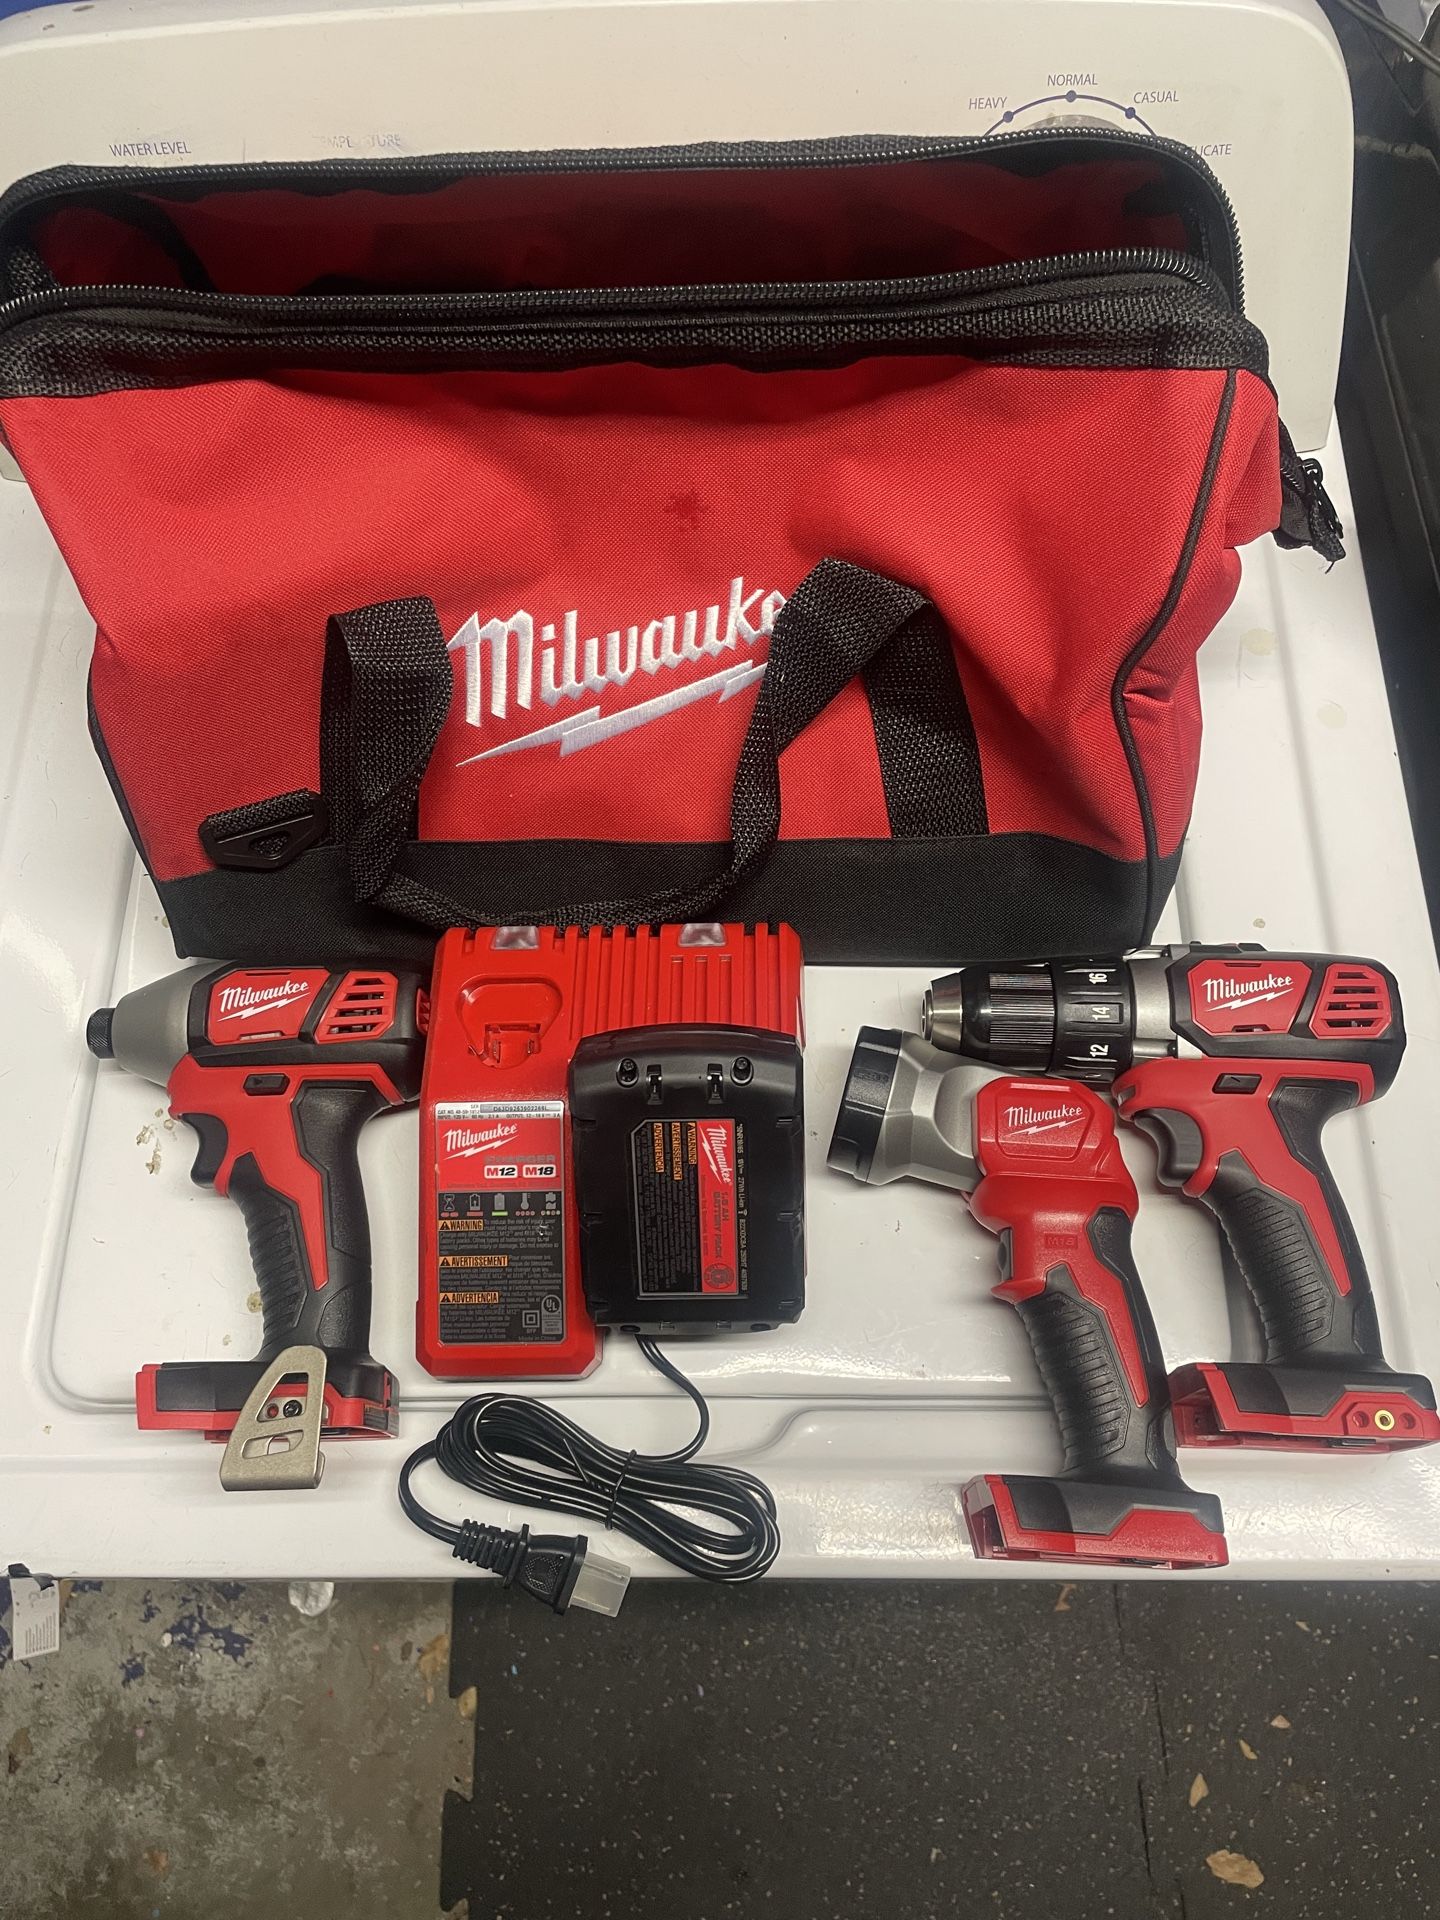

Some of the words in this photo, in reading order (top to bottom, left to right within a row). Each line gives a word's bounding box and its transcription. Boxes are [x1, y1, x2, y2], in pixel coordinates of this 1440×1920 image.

[1047, 73, 1099, 87] NORMAL
[968, 96, 1008, 110] HEAVY
[1133, 90, 1180, 104] CASUAL
[109, 142, 153, 157] WATER
[153, 141, 192, 155] LEVEL
[446, 576, 787, 728] Milwauke
[1088, 972, 1108, 985] 16
[217, 979, 309, 1012] Milwaukee
[1201, 973, 1294, 1004] Milwaukee
[1091, 1006, 1110, 1021] 14
[1089, 1043, 1109, 1058] 12
[1004, 1104, 1083, 1127] Milwaukee
[441, 1123, 518, 1152] Milwaukee
[654, 1123, 664, 1172] ADVERTENCIA
[673, 1123, 682, 1180] AVERTISSEMENT
[688, 1130, 697, 1164] WARNING
[706, 1124, 733, 1184] Milwaukee
[486, 1167, 516, 1177] M12
[525, 1166, 554, 1176] M18
[450, 1220, 483, 1230] WARNING
[451, 1256, 507, 1266] AVERTISSEMENT
[451, 1293, 498, 1303] ADVERTENCIA
